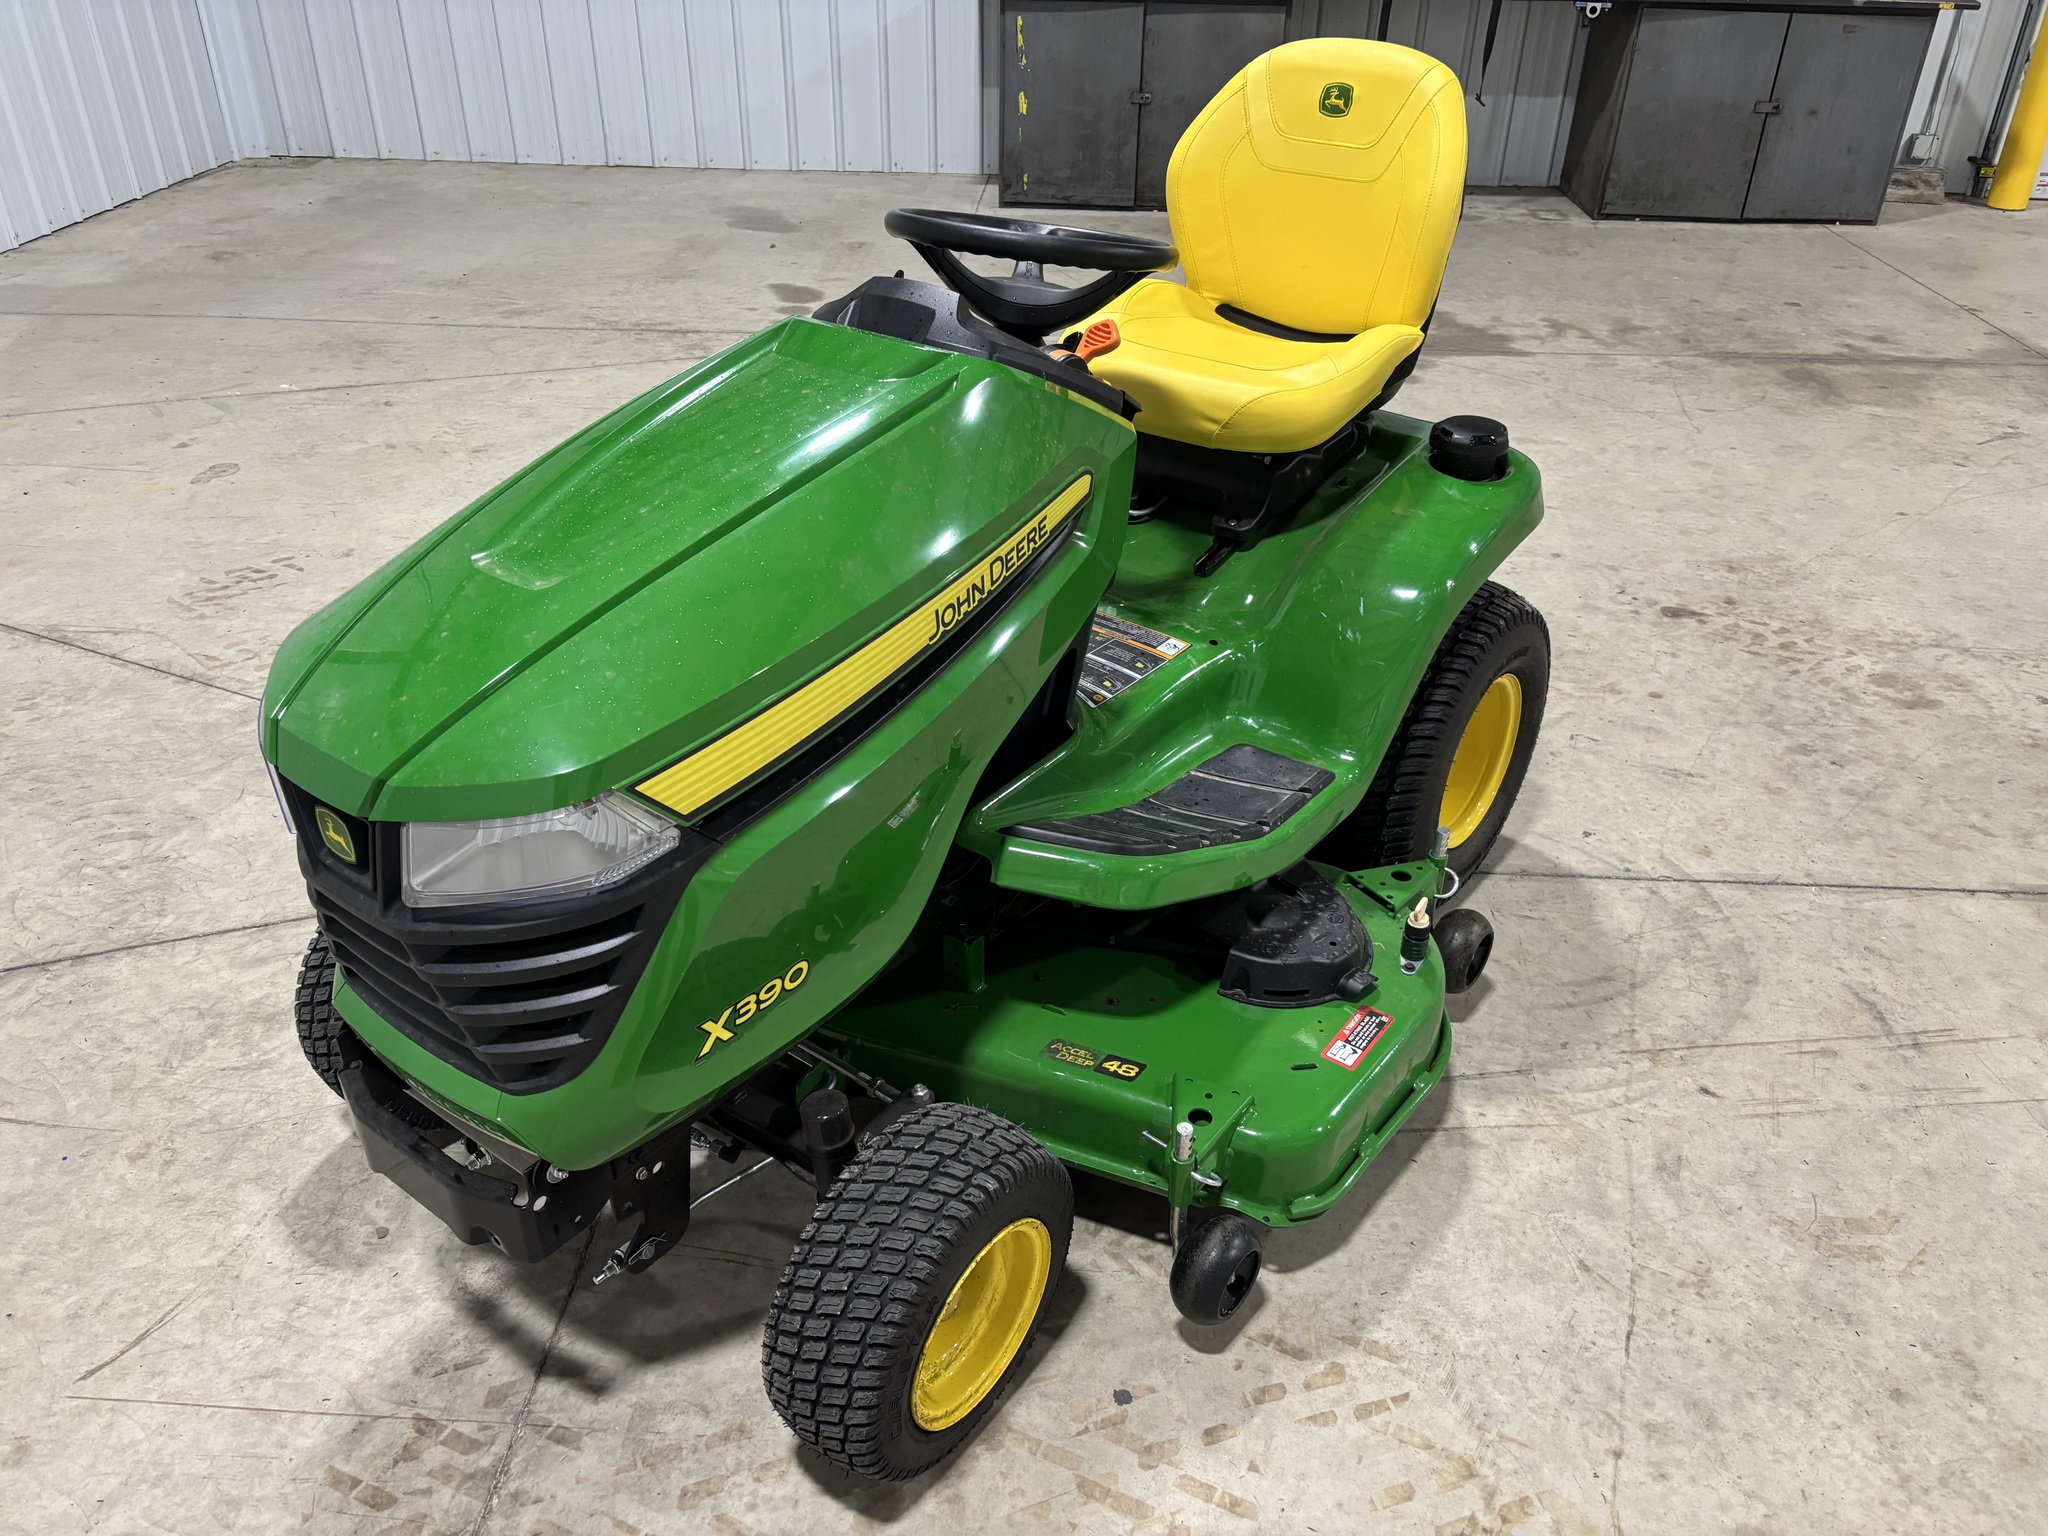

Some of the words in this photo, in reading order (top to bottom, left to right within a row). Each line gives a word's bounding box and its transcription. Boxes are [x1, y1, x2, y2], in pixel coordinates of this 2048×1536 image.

[929, 575, 986, 643] JOHN
[989, 514, 1049, 586] DEERE
[697, 960, 810, 1060] X390
[1345, 1014, 1362, 1030] DANGER
[1050, 1042, 1094, 1060] ACCEL
[1056, 1051, 1095, 1067] DEEP
[1102, 1060, 1140, 1078] 48
